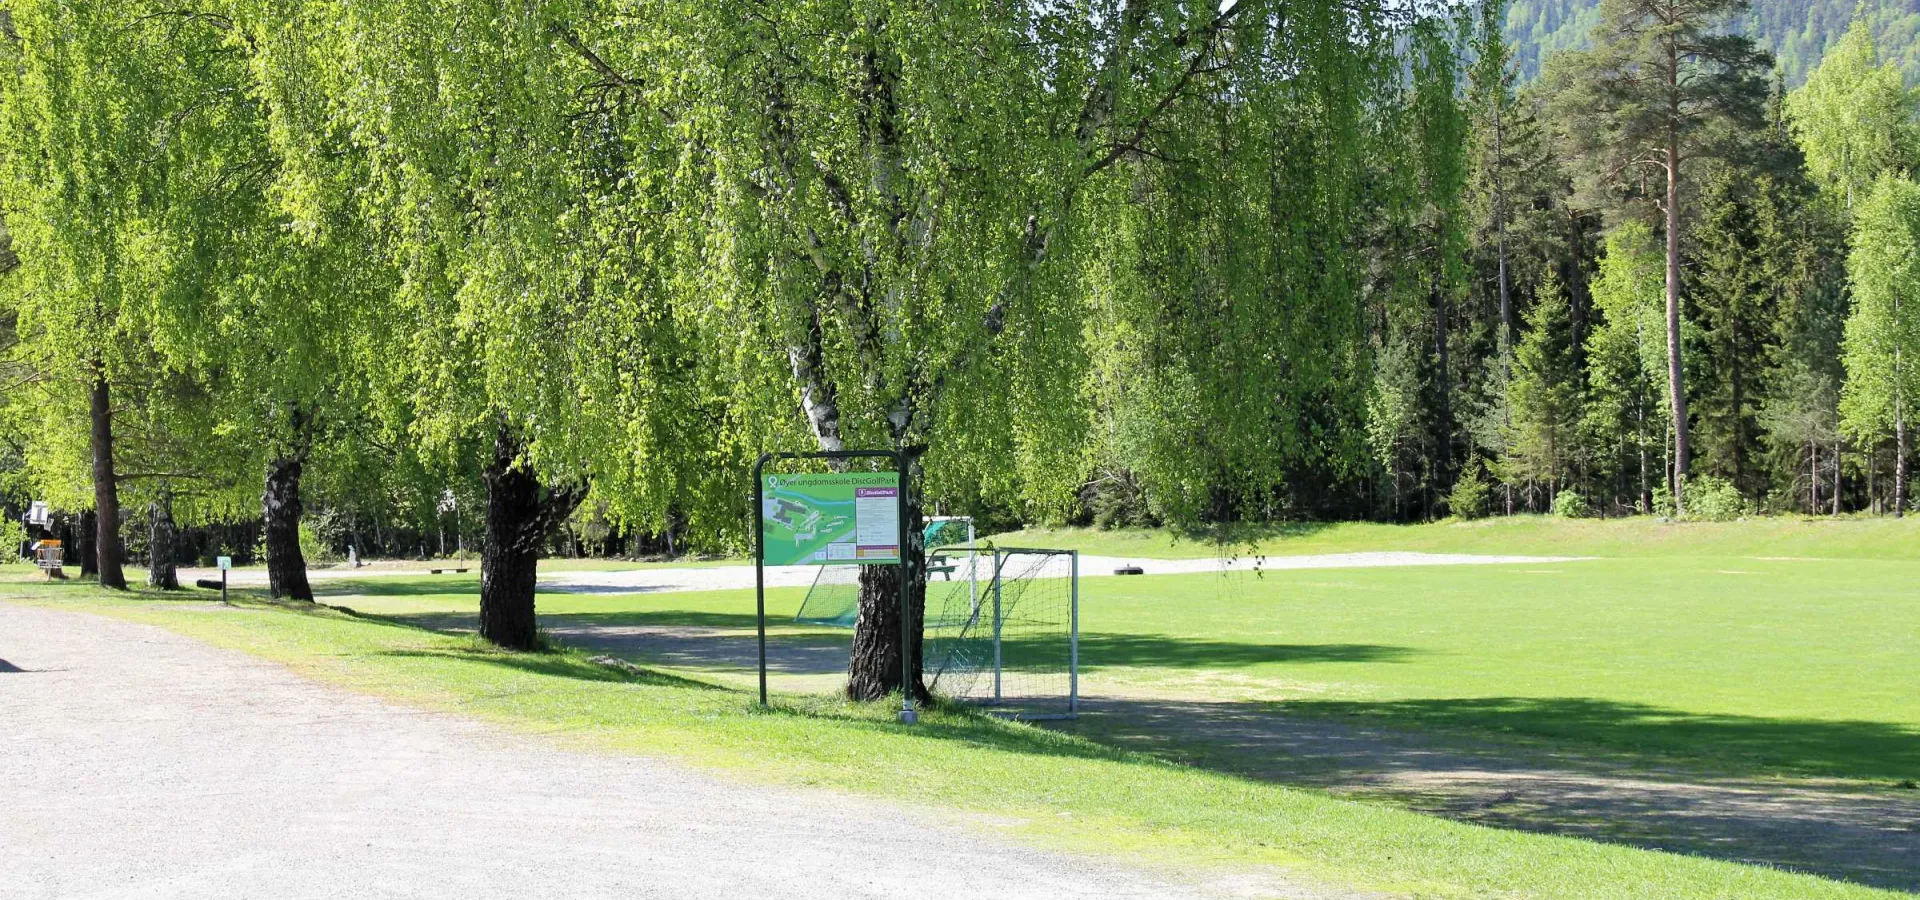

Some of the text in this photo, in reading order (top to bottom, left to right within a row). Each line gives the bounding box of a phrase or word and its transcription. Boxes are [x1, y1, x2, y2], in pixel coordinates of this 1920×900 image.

[779, 477, 896, 487] Øyer ungdomsskole DiscGolfPark
